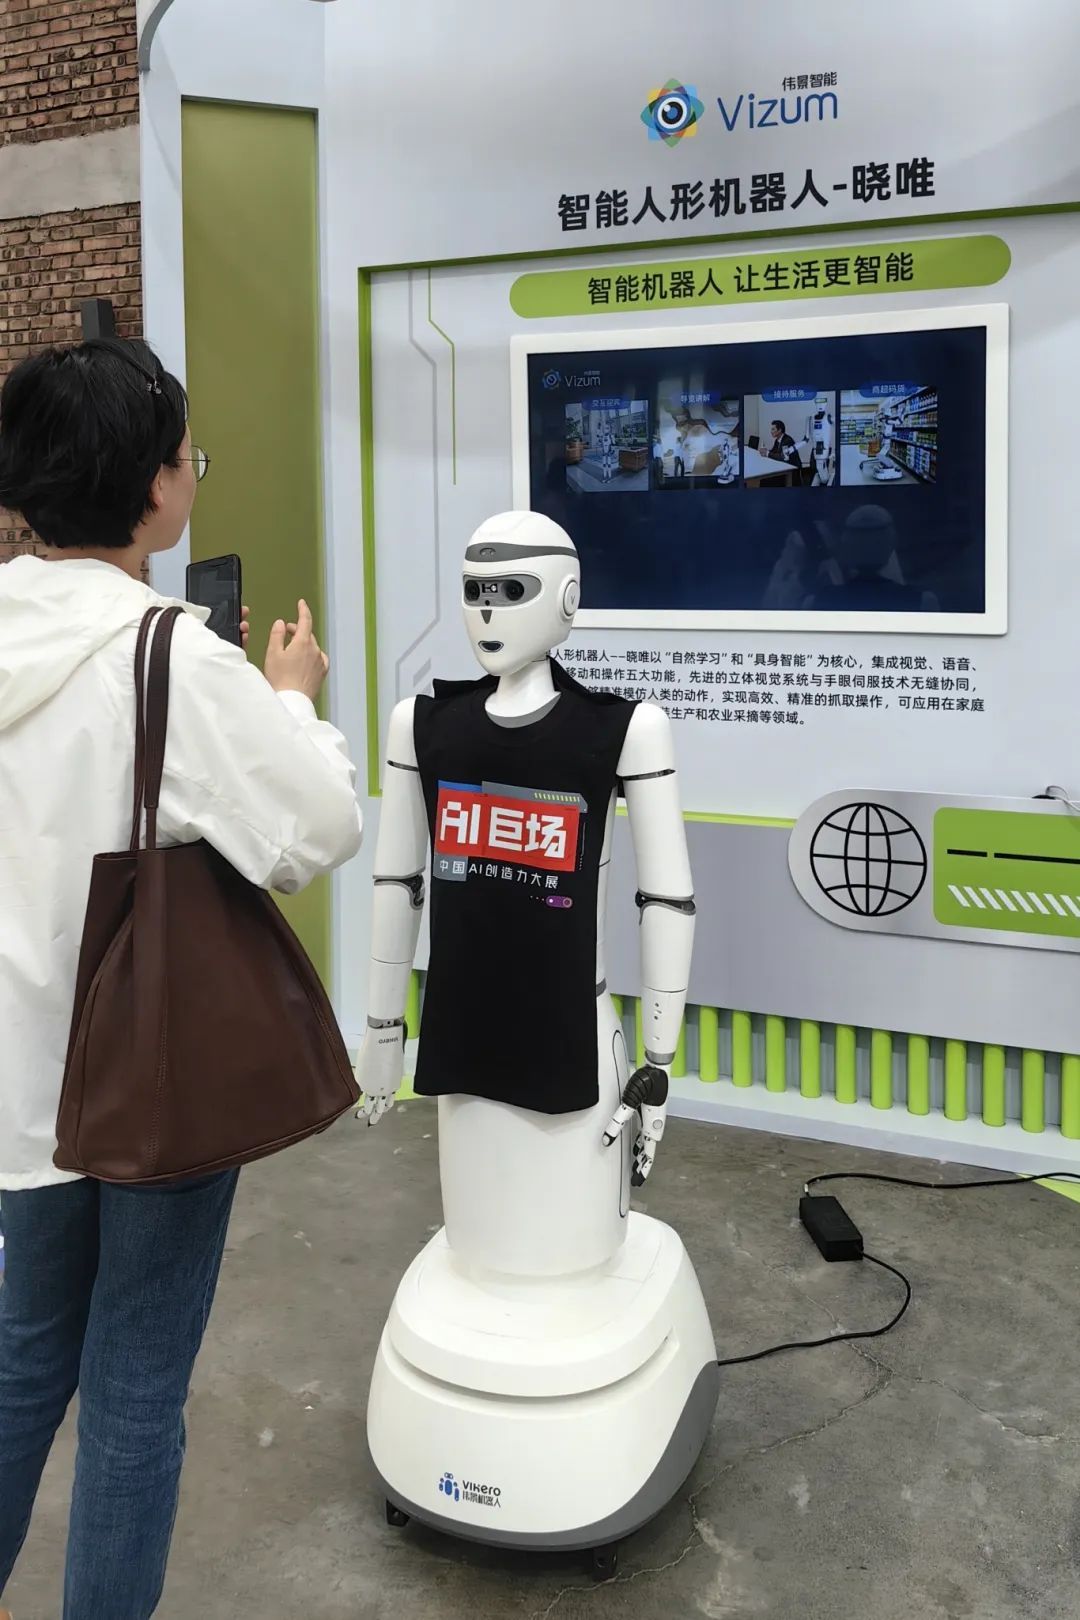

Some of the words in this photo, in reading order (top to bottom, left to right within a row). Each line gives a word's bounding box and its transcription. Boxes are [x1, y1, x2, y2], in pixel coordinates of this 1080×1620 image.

[781, 71, 838, 92] 伟景智能
[717, 91, 838, 132] Vizum
[558, 157, 936, 232] 智能人形机器人-晓唯
[587, 267, 724, 305] 智能机器人
[733, 252, 915, 294] 让生活更智能
[565, 375, 601, 388] Vizum
[439, 860, 559, 889] 中国AI创造力大展
